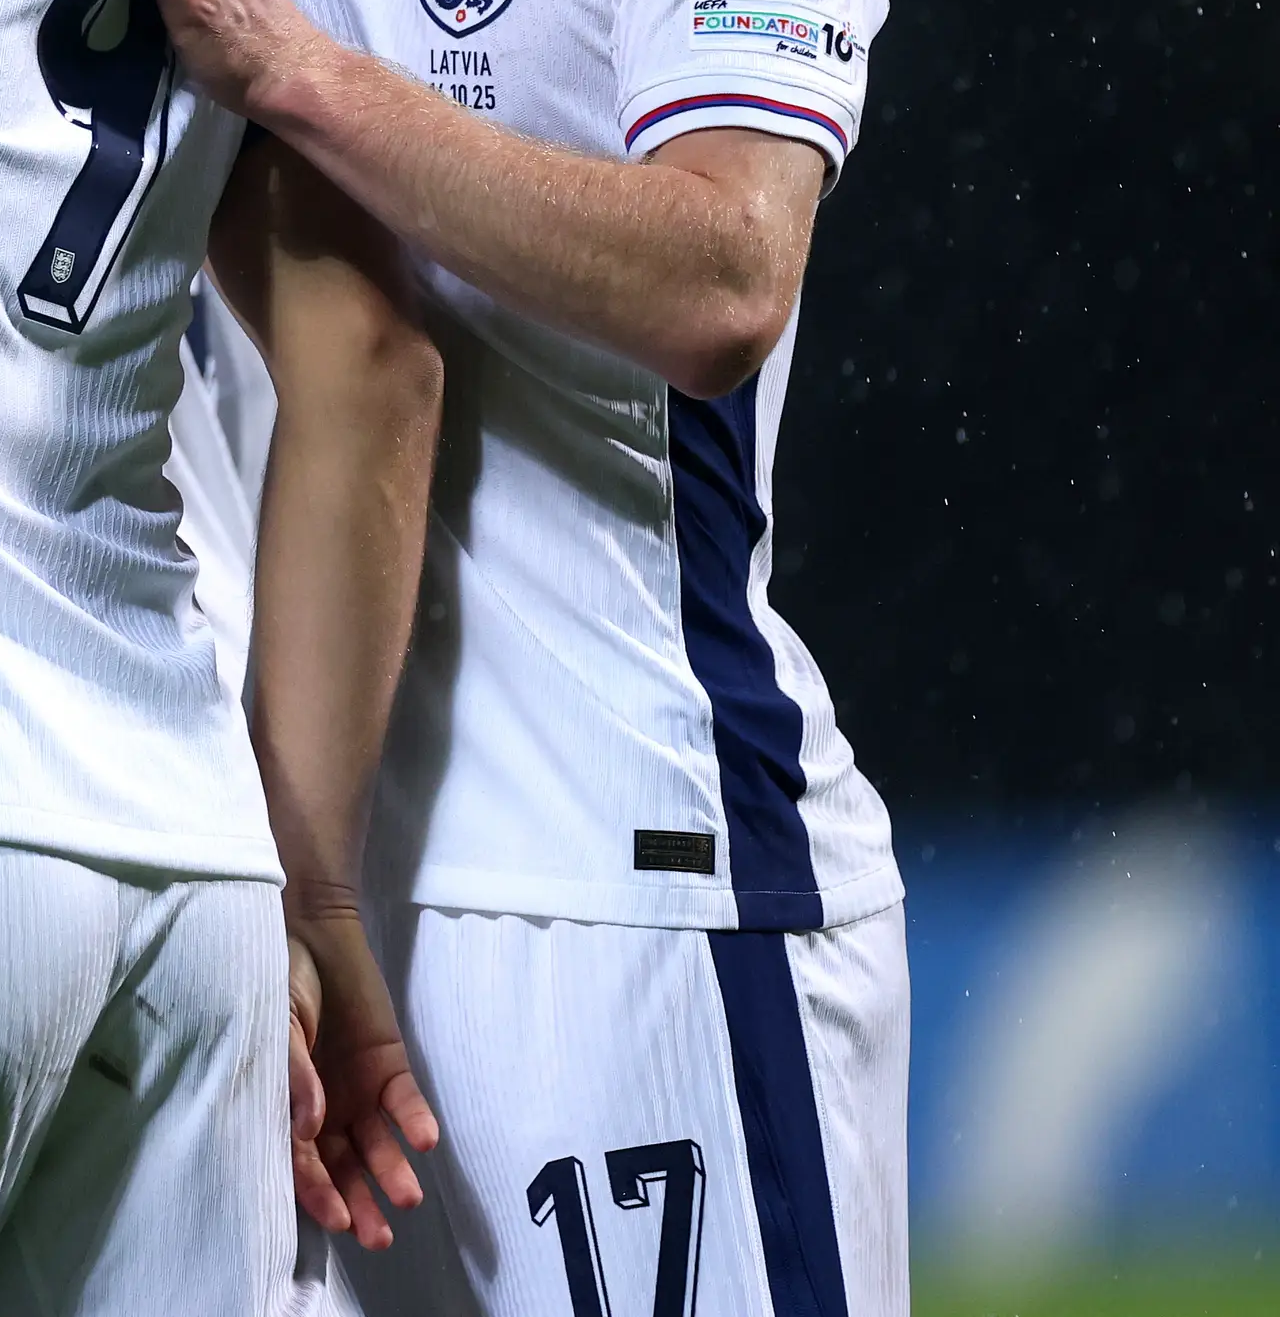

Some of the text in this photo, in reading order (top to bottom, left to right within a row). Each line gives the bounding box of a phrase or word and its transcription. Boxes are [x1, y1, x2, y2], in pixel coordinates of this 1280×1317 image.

[693, 0, 728, 10] UEFA
[693, 15, 819, 43] FOUNDATION
[821, 22, 853, 63] 10
[430, 49, 492, 77] LATVIA
[776, 40, 818, 60] for children
[526, 1138, 706, 1317] 17
